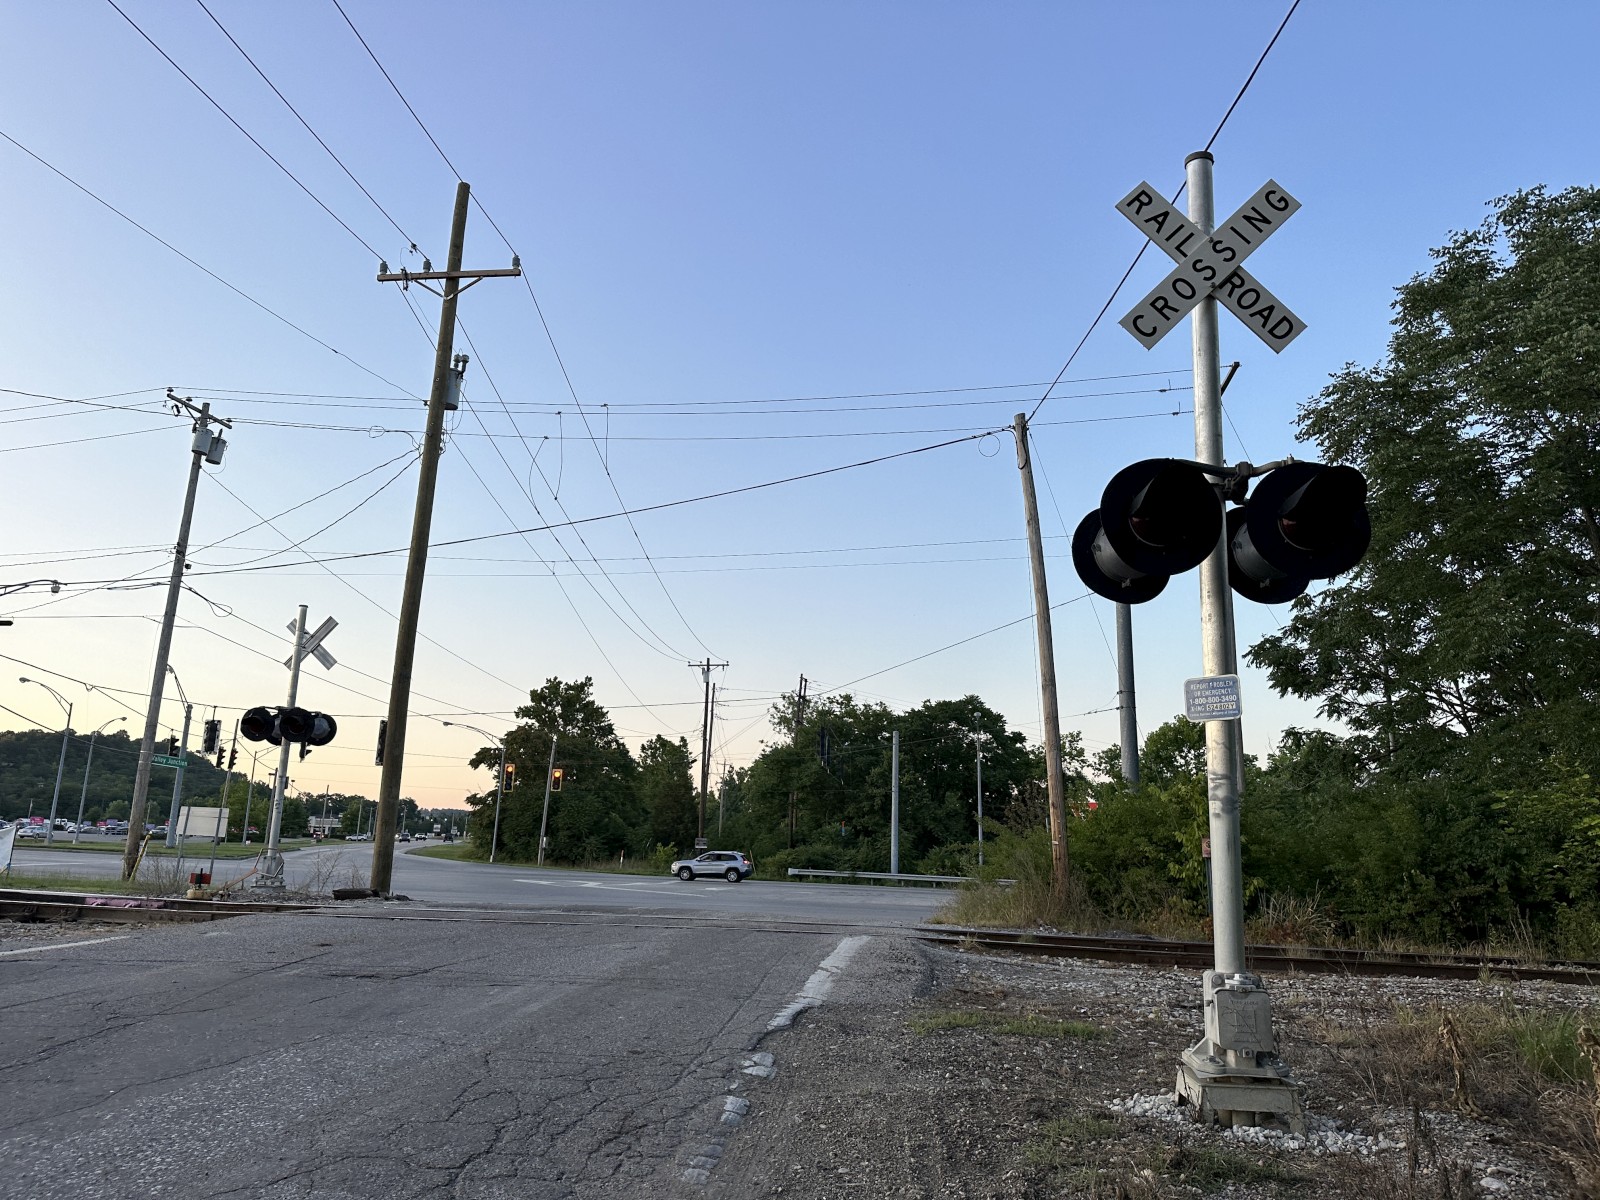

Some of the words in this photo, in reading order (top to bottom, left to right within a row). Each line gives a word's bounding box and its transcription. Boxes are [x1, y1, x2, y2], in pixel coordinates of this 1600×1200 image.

[1126, 189, 1195, 258] RAIL
[1218, 270, 1294, 340] ROAD
[1132, 190, 1289, 338] CROSSING
[1201, 688, 1231, 696] EMERGENCY
[1189, 695, 1237, 704] 1-800-800-3490
[167, 758, 187, 766] Junction
